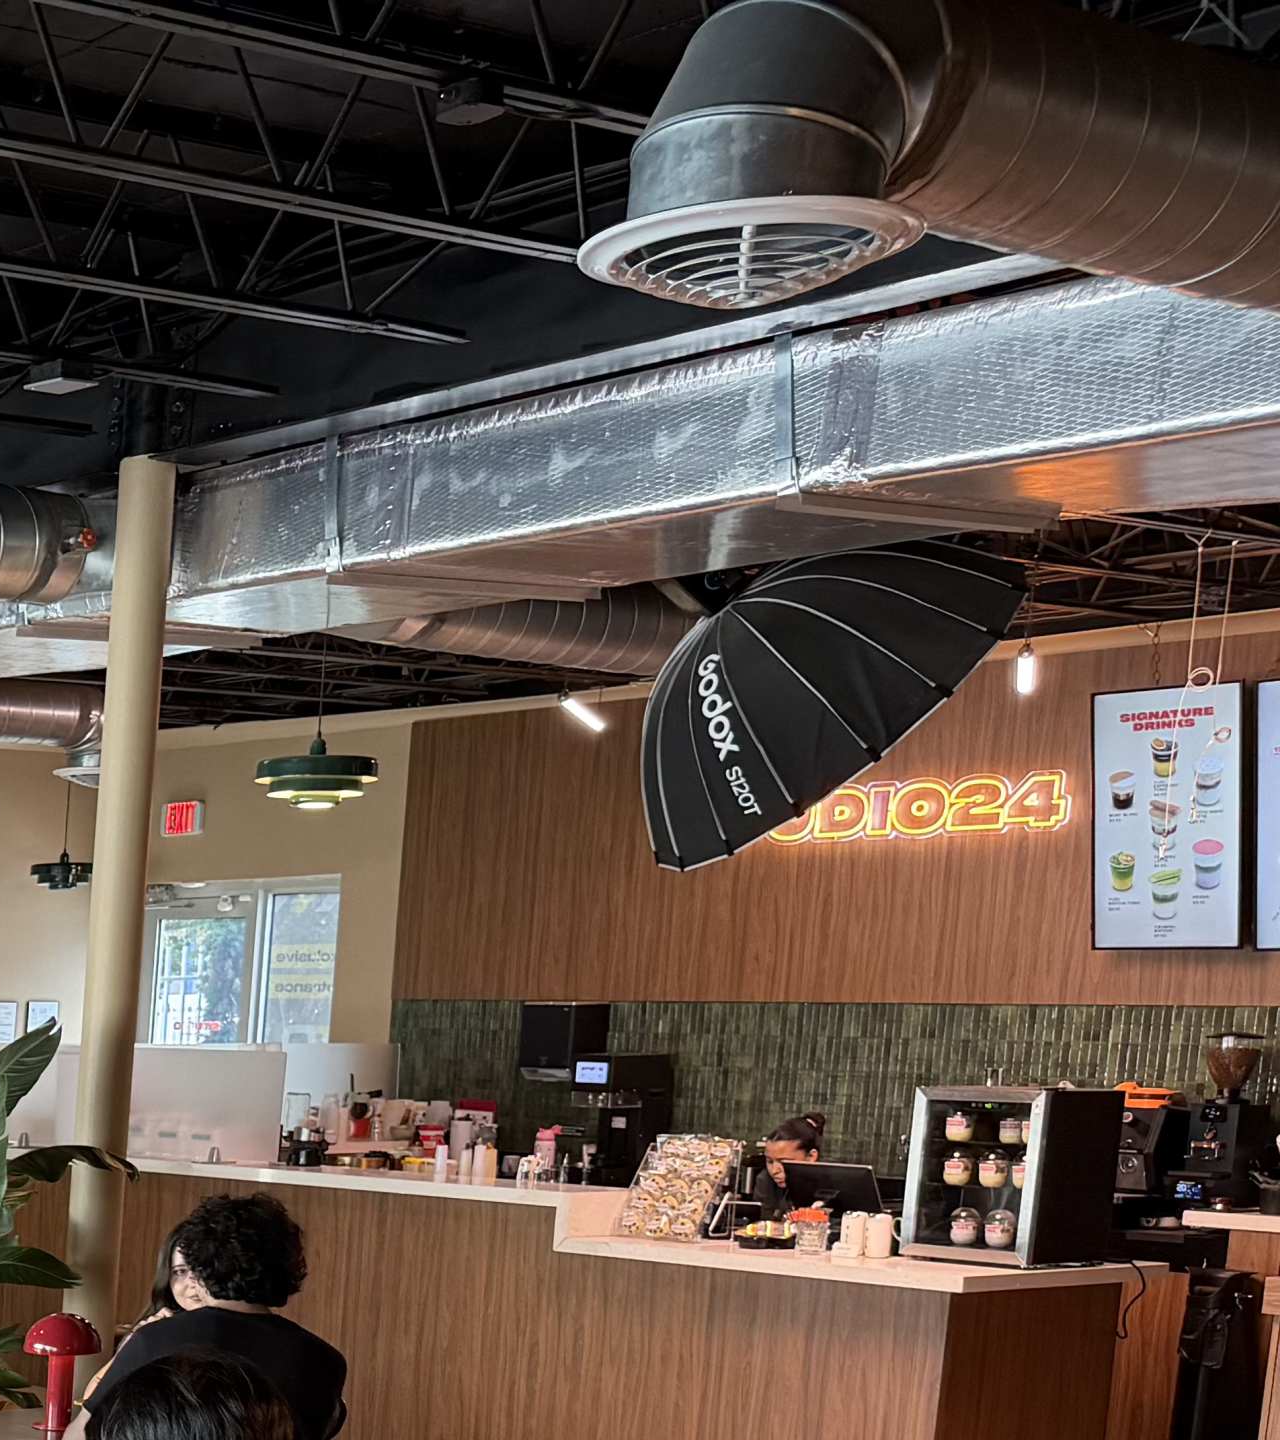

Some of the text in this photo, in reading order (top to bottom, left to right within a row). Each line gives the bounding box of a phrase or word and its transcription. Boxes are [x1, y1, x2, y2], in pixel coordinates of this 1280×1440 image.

[1120, 706, 1215, 723] SIGNATURE
[1132, 718, 1196, 732] DRINKS
[697, 653, 762, 816] Godox S120T
[166, 801, 197, 834] EXIT
